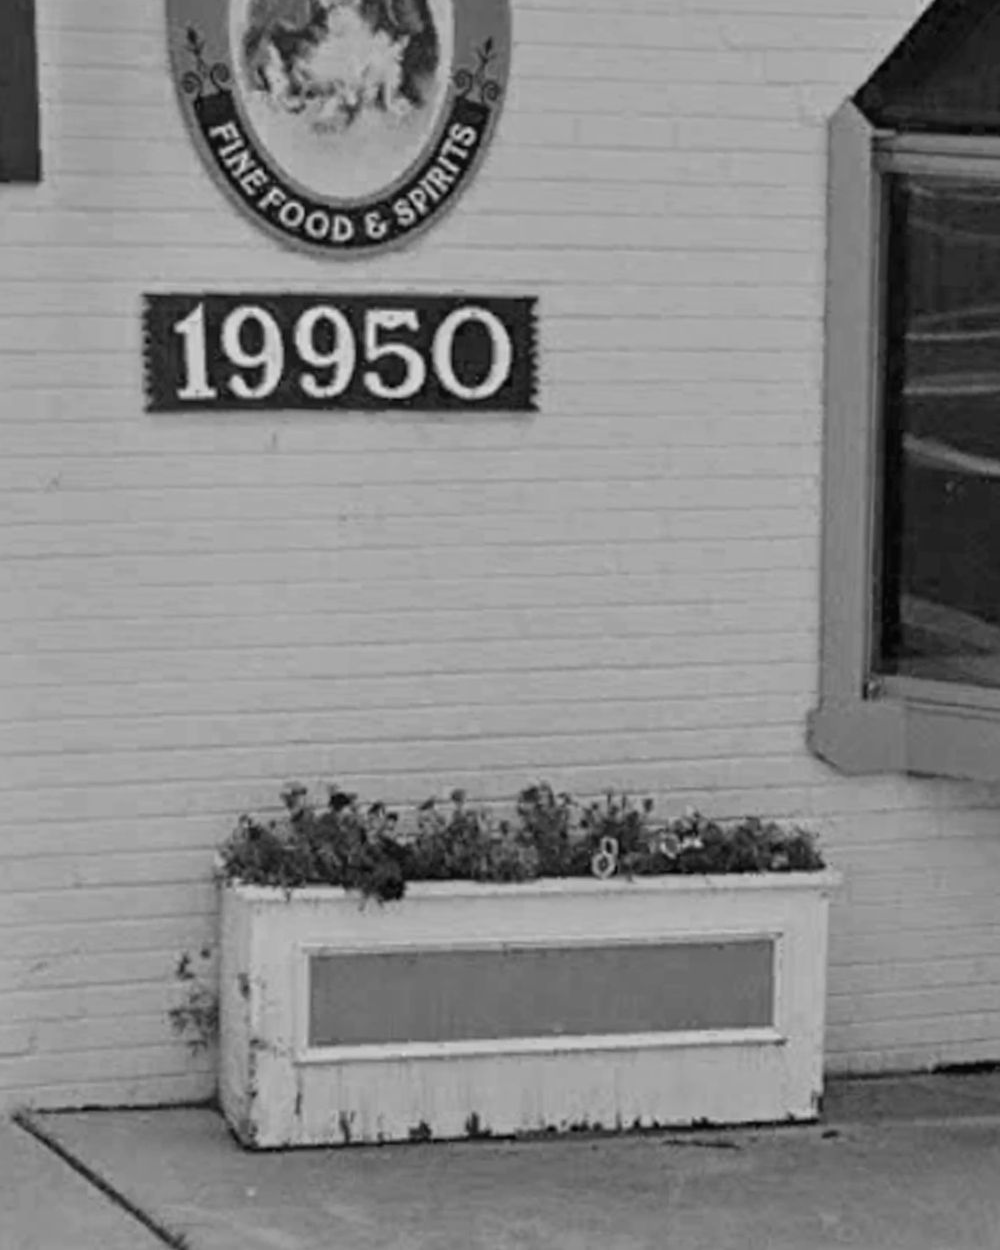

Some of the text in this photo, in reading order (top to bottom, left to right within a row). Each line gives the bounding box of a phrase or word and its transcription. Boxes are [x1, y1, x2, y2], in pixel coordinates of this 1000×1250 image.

[209, 122, 477, 242] FINE FOOD & SPIRITS
[174, 302, 513, 401] 19950
